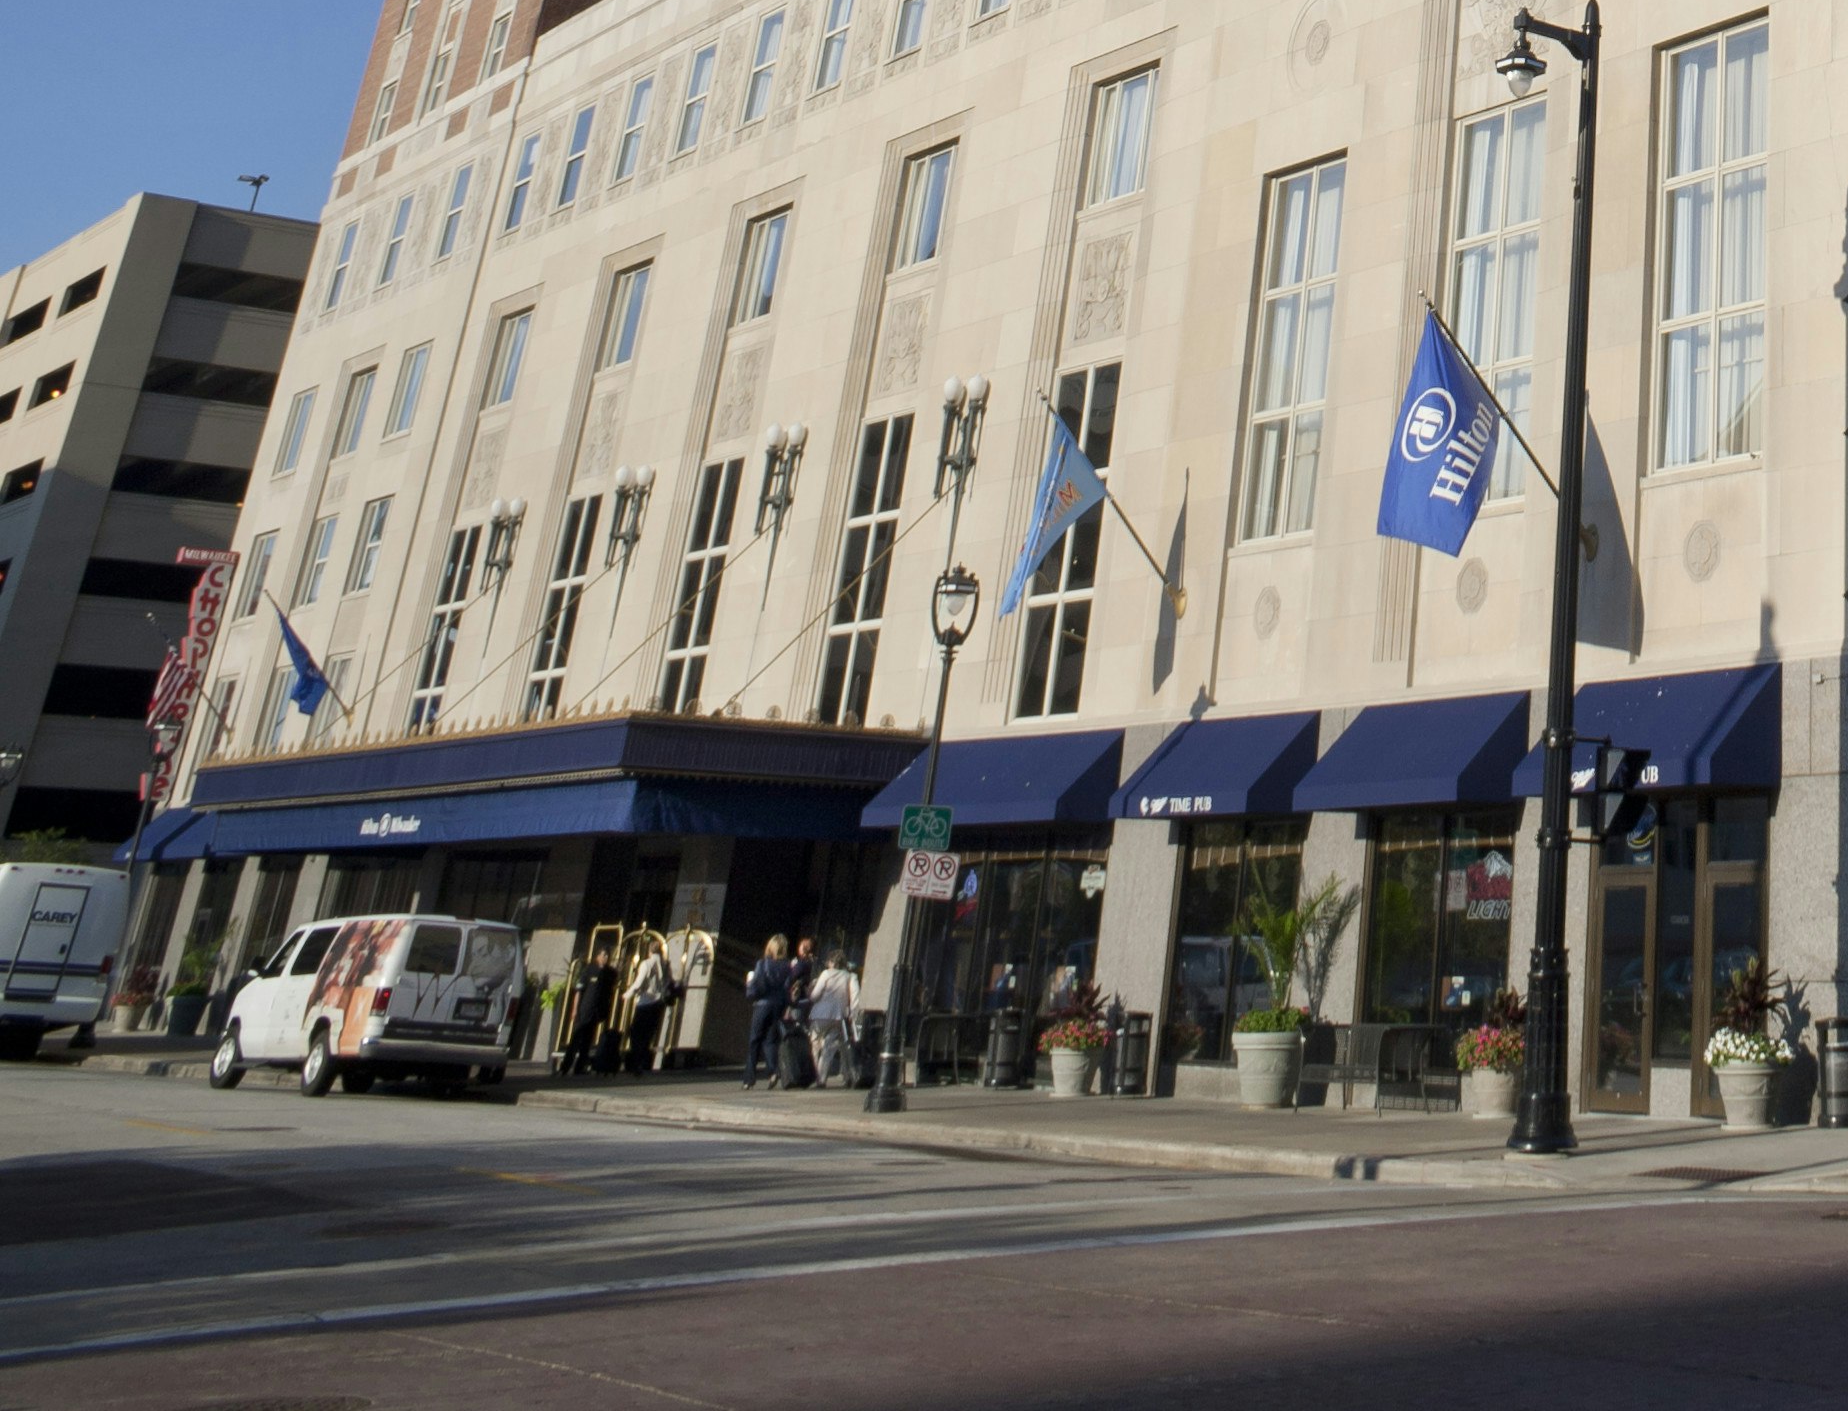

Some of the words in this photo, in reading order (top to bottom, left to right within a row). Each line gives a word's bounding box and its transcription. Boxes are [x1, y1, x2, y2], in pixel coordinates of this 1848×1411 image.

[1429, 401, 1495, 507] Hilton
[184, 548, 236, 563] MILWAUKEE
[151, 565, 225, 799] CHOPHOE
[1169, 797, 1192, 813] TIME
[1193, 796, 1212, 812] PUB
[31, 910, 78, 924] CAREY
